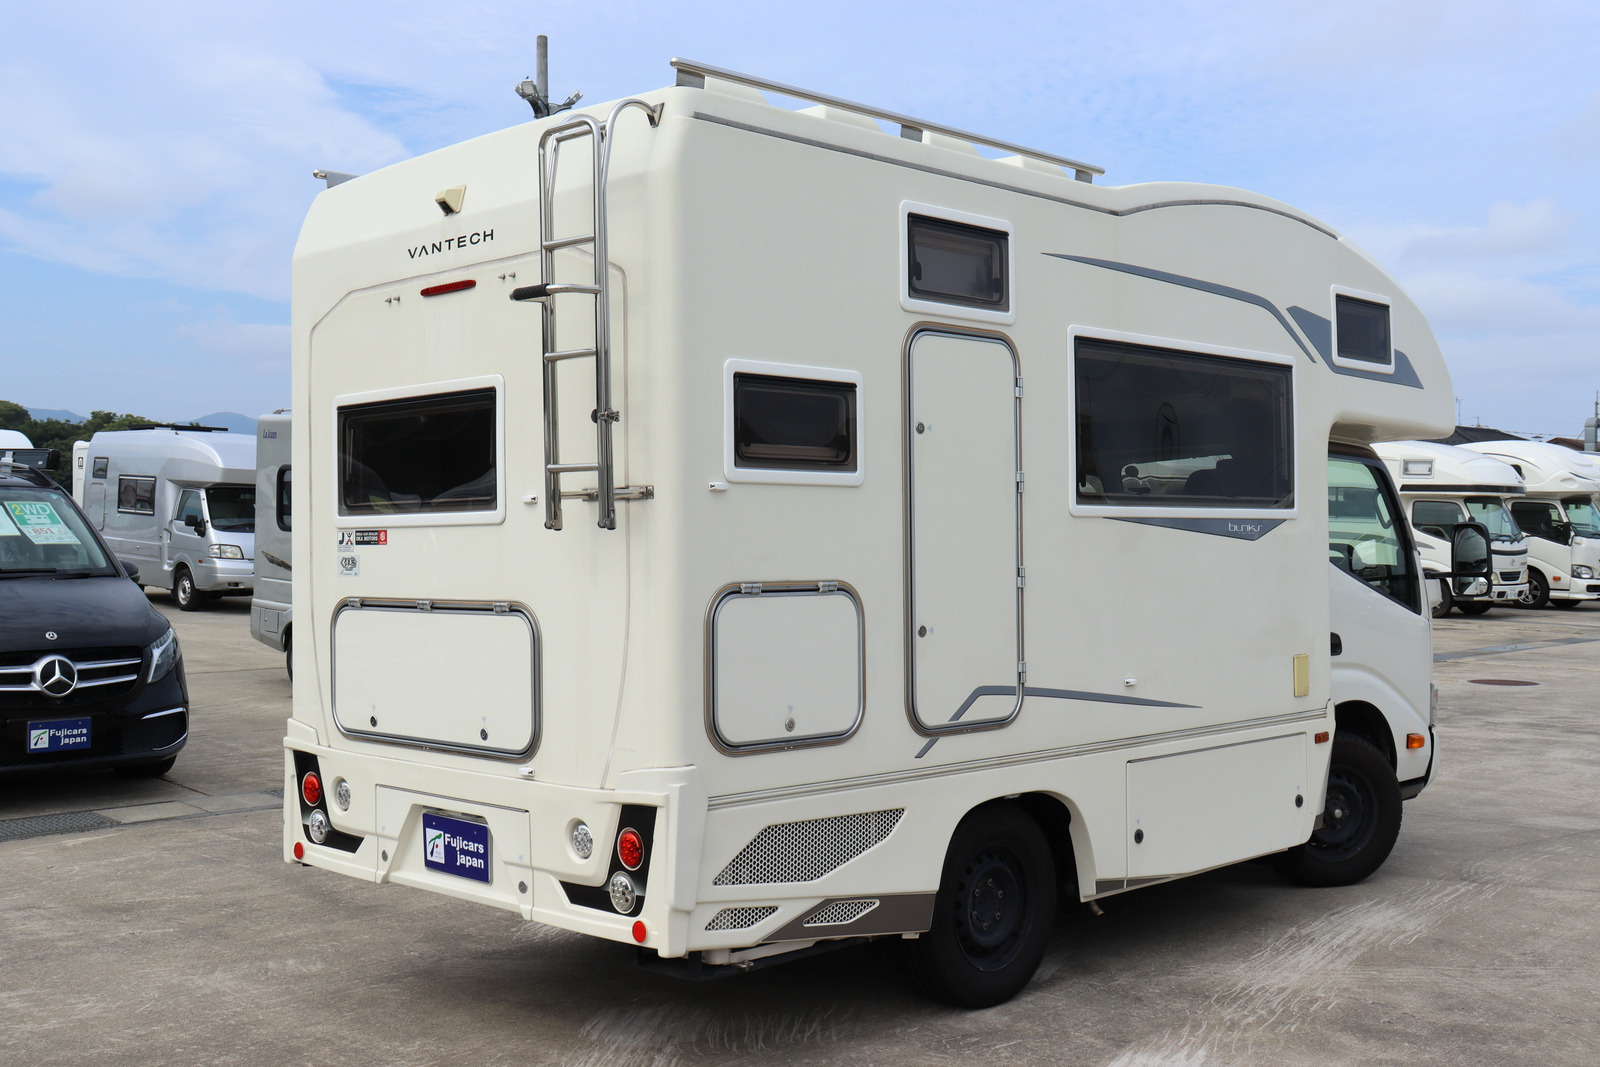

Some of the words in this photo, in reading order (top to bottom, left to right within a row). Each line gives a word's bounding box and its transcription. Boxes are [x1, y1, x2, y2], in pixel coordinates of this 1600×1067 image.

[408, 229, 494, 259] VANTECH
[11, 504, 50, 515] 2WD
[50, 728, 87, 737] Fujicars
[60, 736, 87, 746] japan
[444, 833, 485, 853] Fujicars
[456, 851, 485, 869] japan
